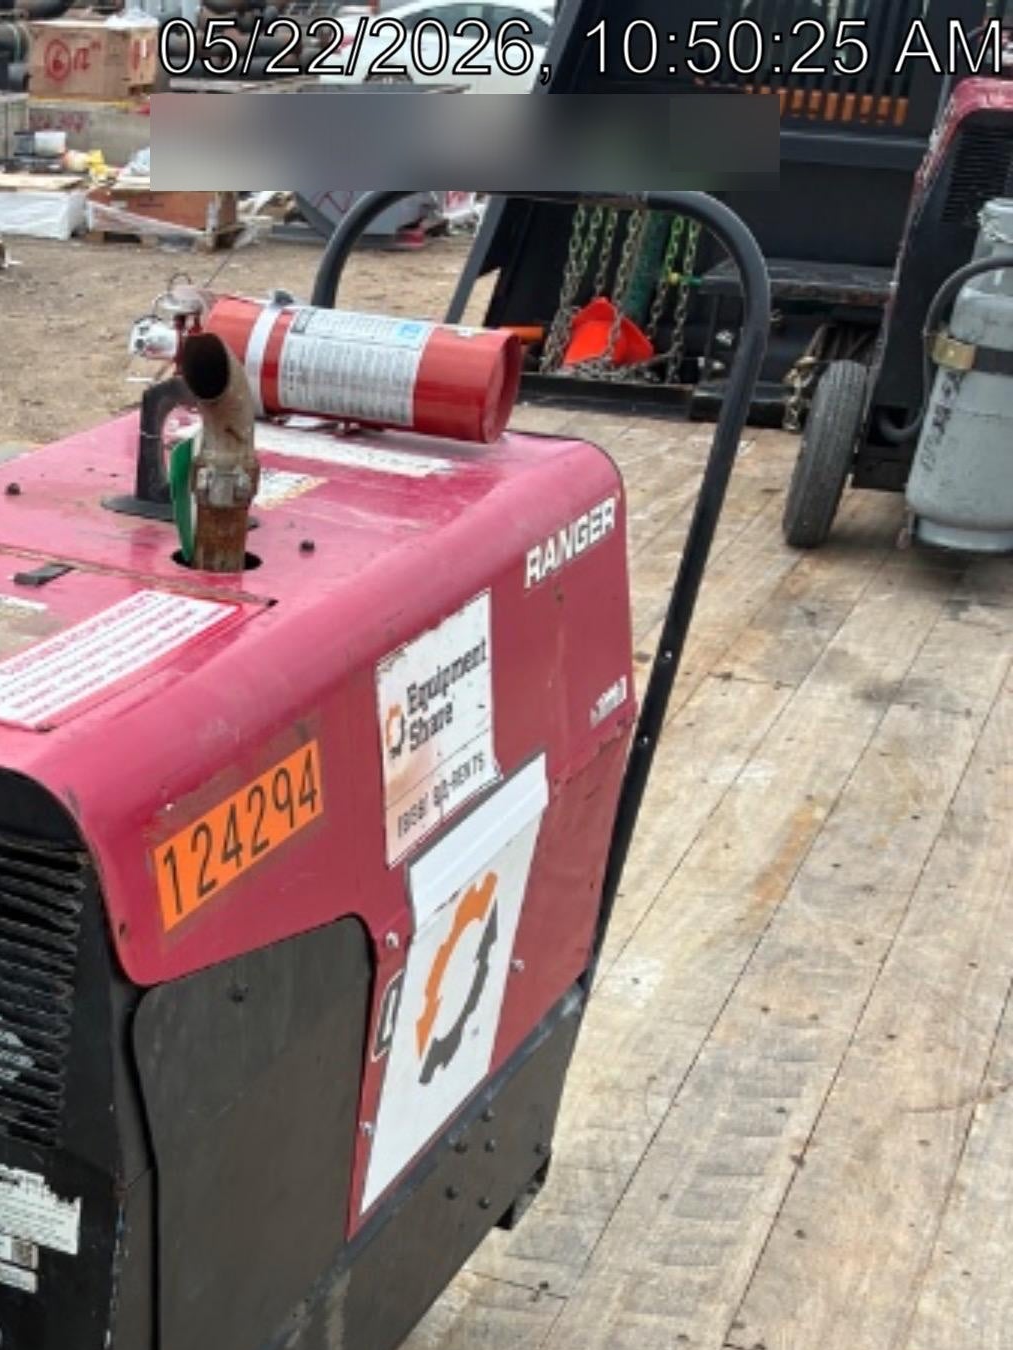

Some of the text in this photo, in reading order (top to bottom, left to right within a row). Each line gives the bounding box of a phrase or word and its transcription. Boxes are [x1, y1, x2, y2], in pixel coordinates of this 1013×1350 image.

[524, 497, 616, 589] RANGER
[407, 637, 487, 714] Equipment
[409, 701, 454, 753] Share
[162, 749, 318, 915] 124294
